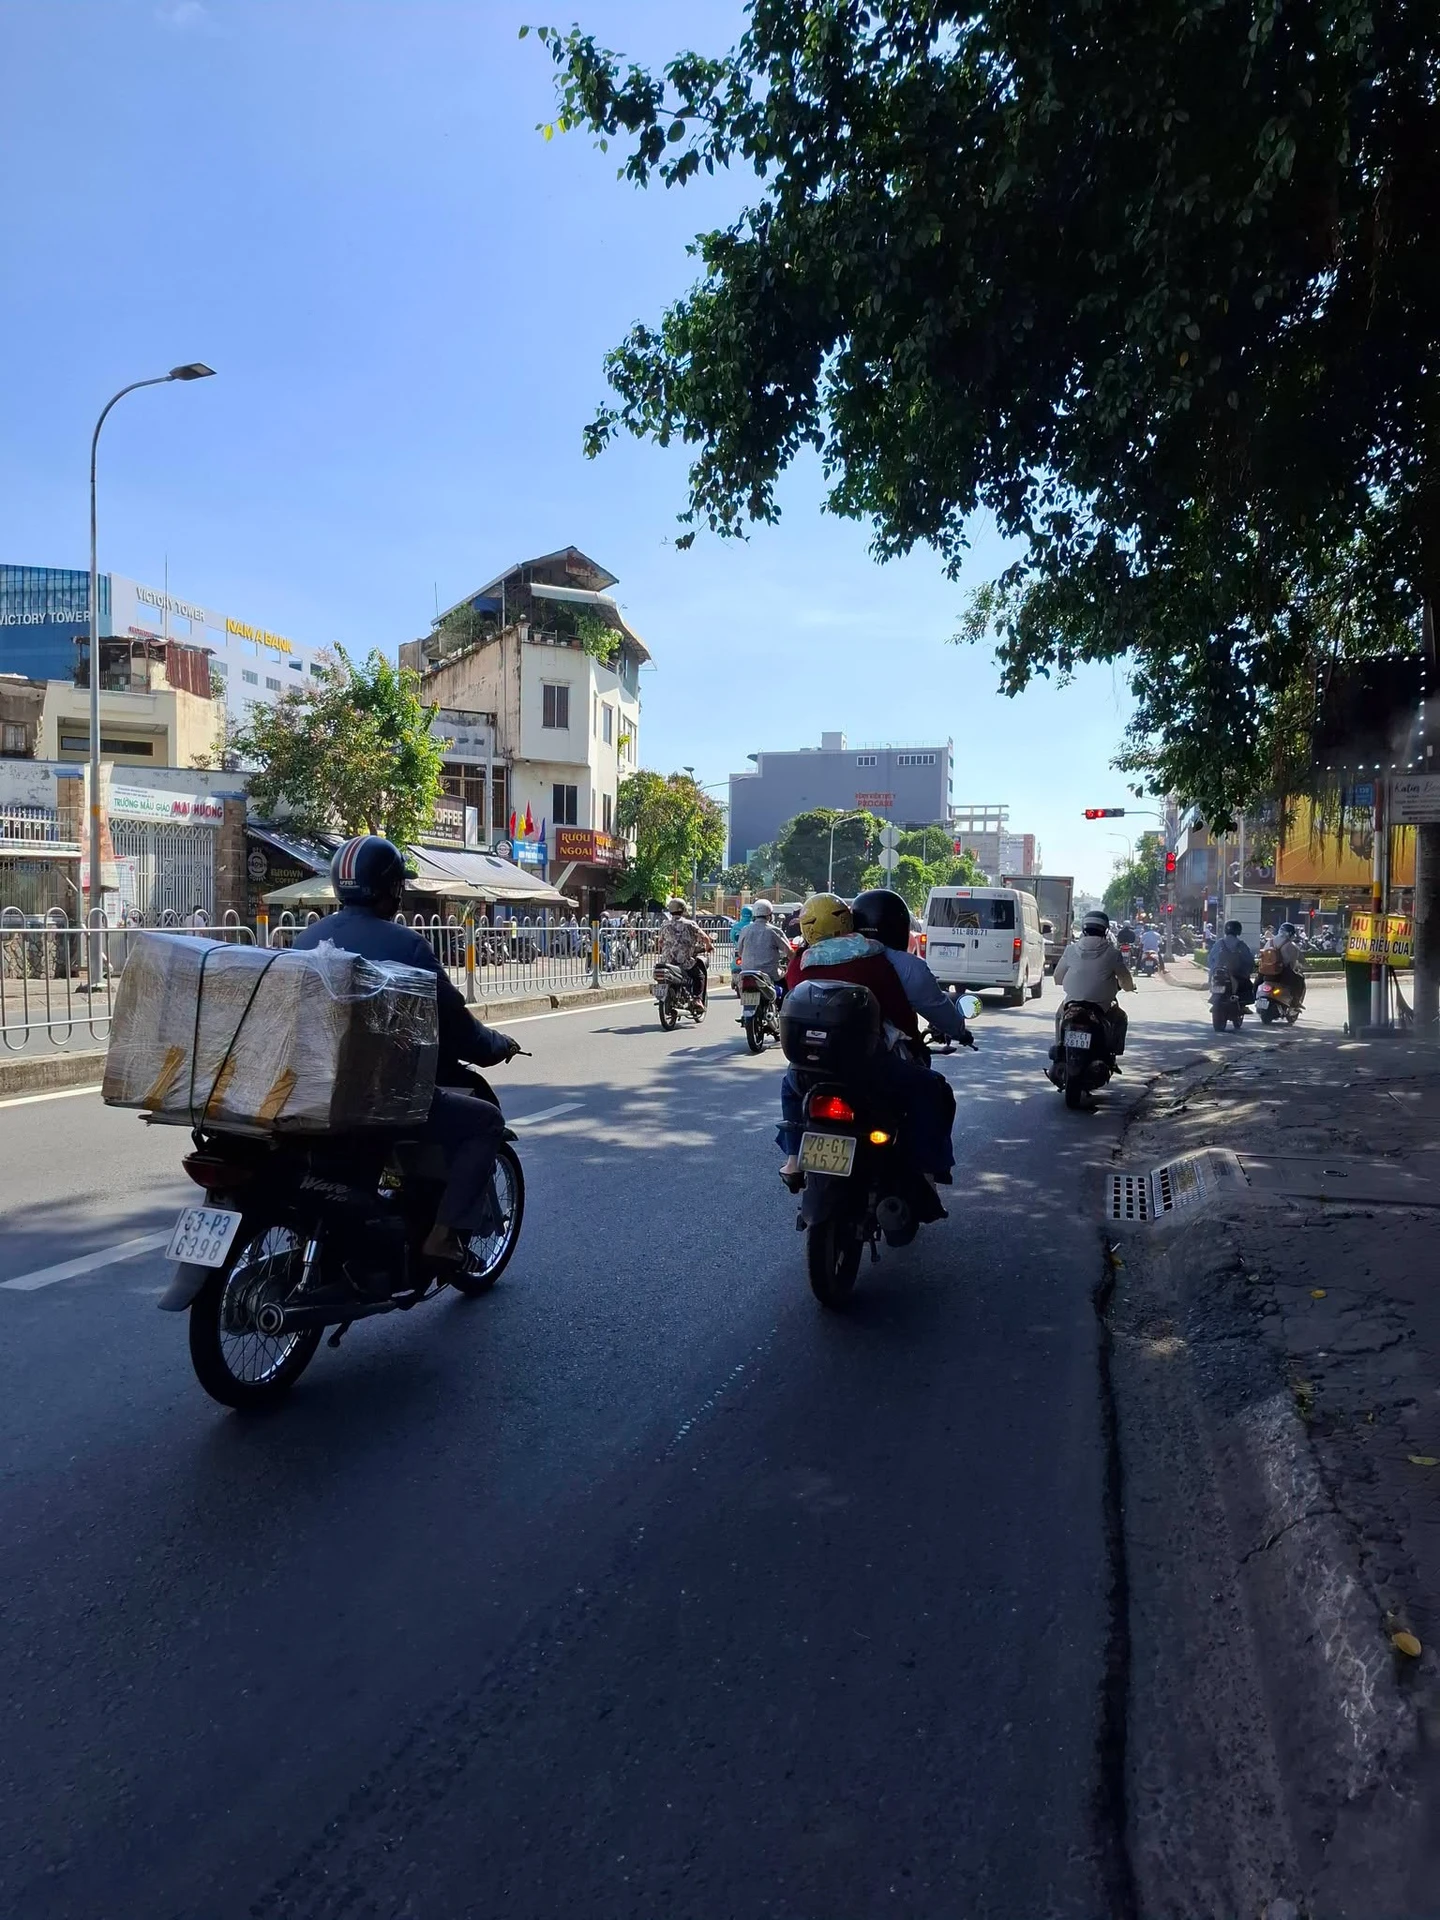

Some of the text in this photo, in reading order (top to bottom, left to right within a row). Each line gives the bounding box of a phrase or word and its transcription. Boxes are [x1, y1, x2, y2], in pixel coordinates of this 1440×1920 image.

[137, 586, 205, 622] VICTORY TOWER
[51, 610, 91, 623] TOWER
[226, 617, 293, 655] NAM A BANK
[561, 832, 591, 844] RƯỢU
[1206, 833, 1241, 846] KNH
[559, 846, 592, 857] NGOẠI
[270, 868, 304, 878] BROWN
[1392, 941, 1409, 956] CUA
[1368, 954, 1390, 964] 25K
[808, 1135, 847, 1155] 78-G1
[299, 1175, 351, 1194] Wave
[184, 1210, 231, 1236] 53-P3
[175, 1234, 222, 1261] 6398
